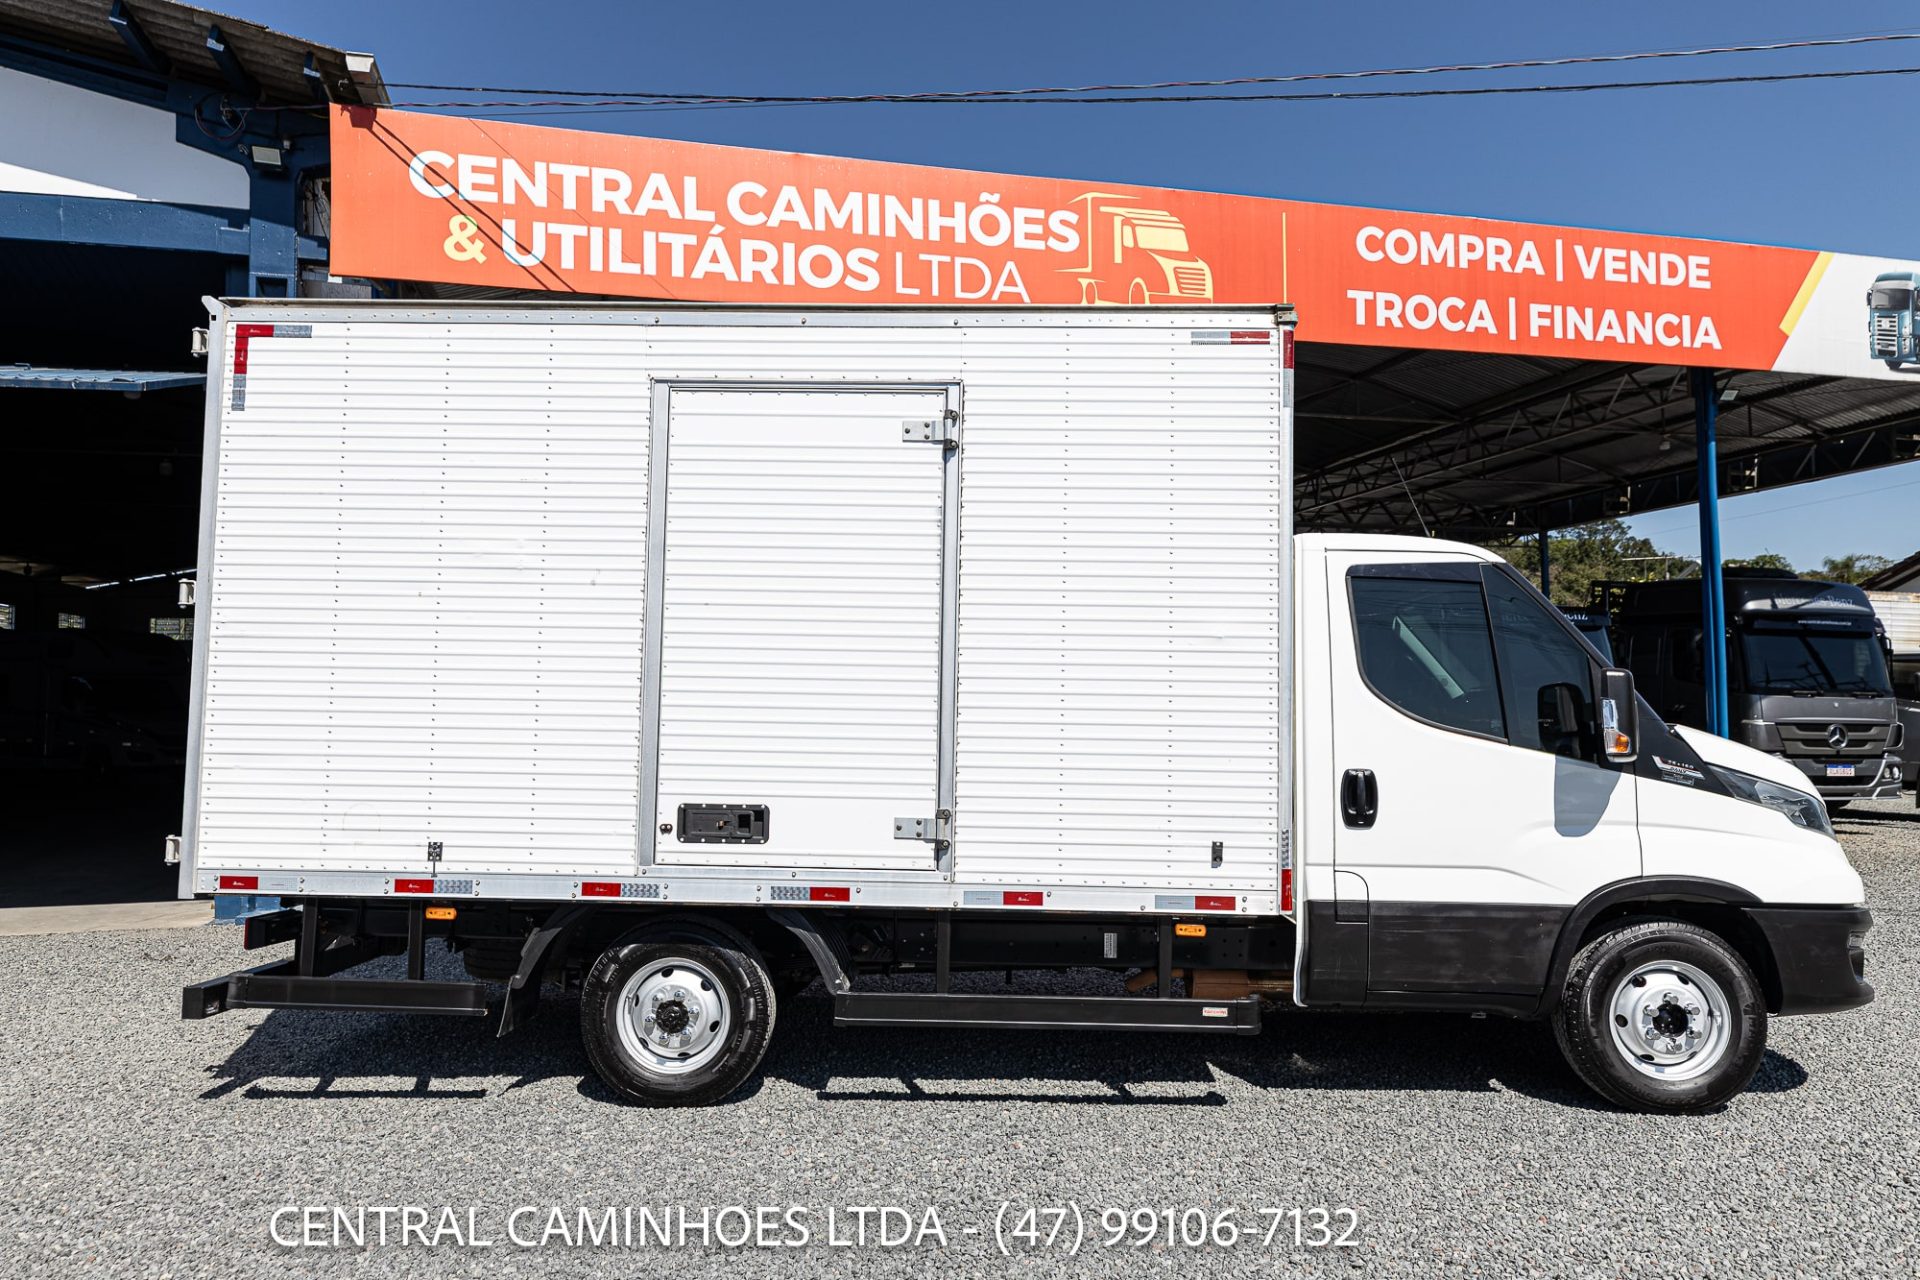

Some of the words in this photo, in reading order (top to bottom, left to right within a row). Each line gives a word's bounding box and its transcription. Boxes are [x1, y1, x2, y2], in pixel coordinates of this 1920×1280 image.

[408, 149, 716, 223] CENTRAL
[726, 180, 1081, 253] CAMINHÕES
[443, 214, 487, 264] &
[501, 218, 881, 292] UTILITÁRIOS
[895, 251, 1032, 303] LTDA
[1355, 225, 1546, 276] COMPRA
[1573, 244, 1712, 290] VENDE
[1346, 289, 1498, 335] TROCA
[1529, 303, 1722, 350] FINANCIA
